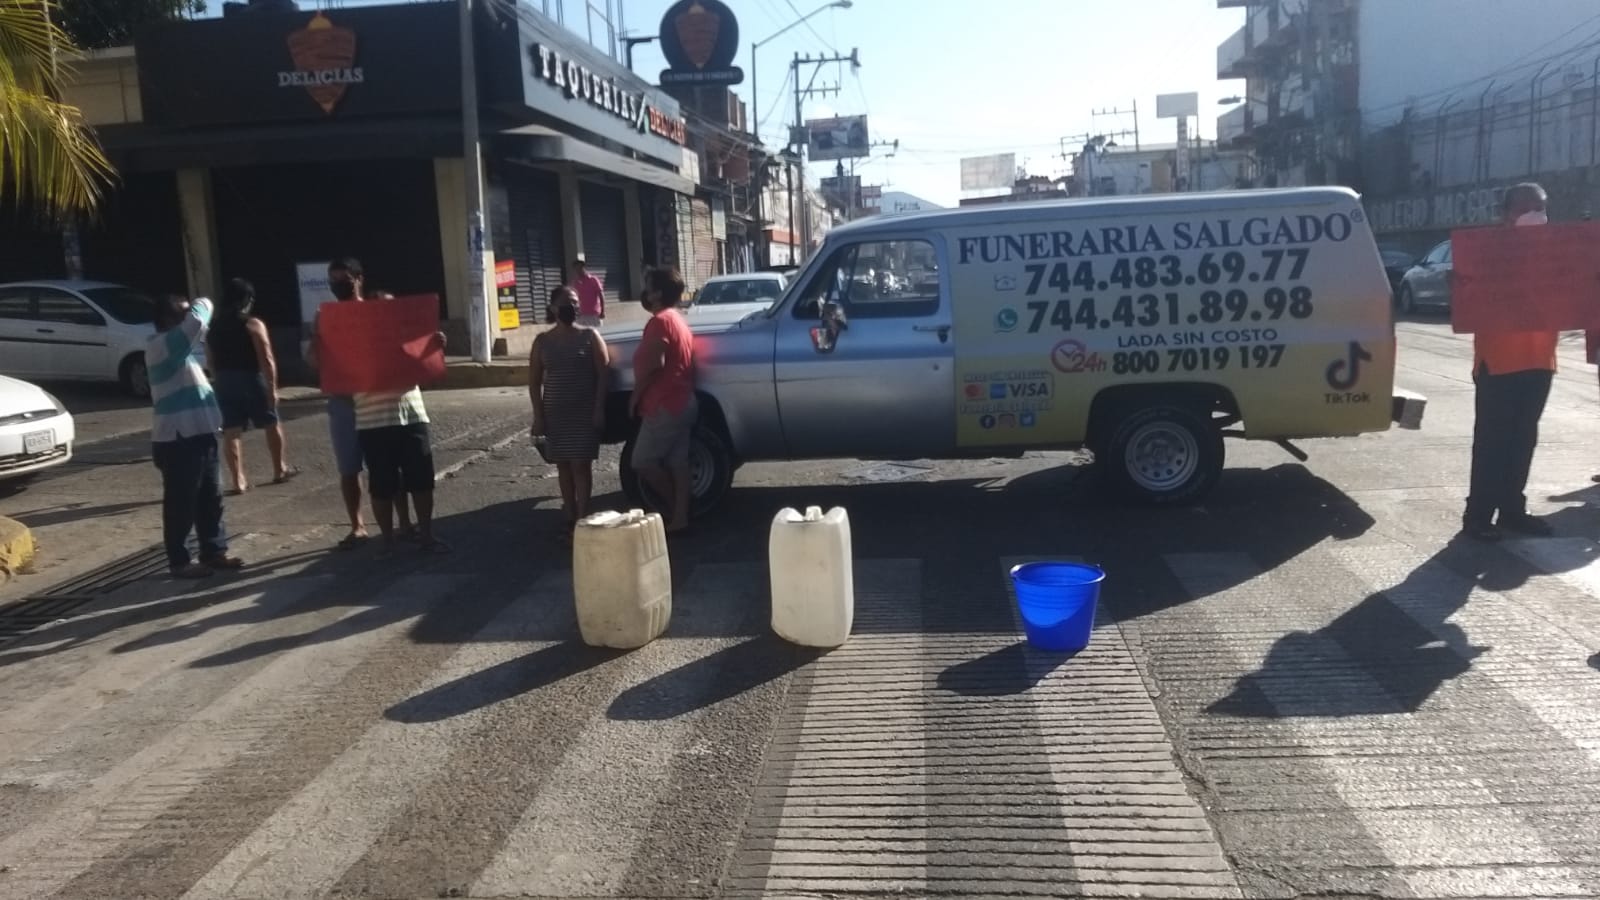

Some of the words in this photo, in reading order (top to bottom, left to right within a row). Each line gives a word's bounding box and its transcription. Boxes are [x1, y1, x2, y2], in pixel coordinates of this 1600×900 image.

[277, 66, 364, 87] DELICIAS
[957, 223, 1166, 264] FUNERARIA
[1173, 212, 1352, 250] SALGADO
[1025, 247, 1311, 296] 744.483.69.77
[1027, 286, 1314, 334] 744.431.89.98
[1117, 333, 1167, 348] LADA
[1175, 331, 1204, 345] SIN
[1211, 328, 1278, 343] COSTO
[1111, 350, 1160, 375] 800
[1167, 346, 1230, 372] 7019
[1239, 344, 1287, 369] 197
[1009, 382, 1049, 398] VISA
[1324, 391, 1371, 405] TikTok
